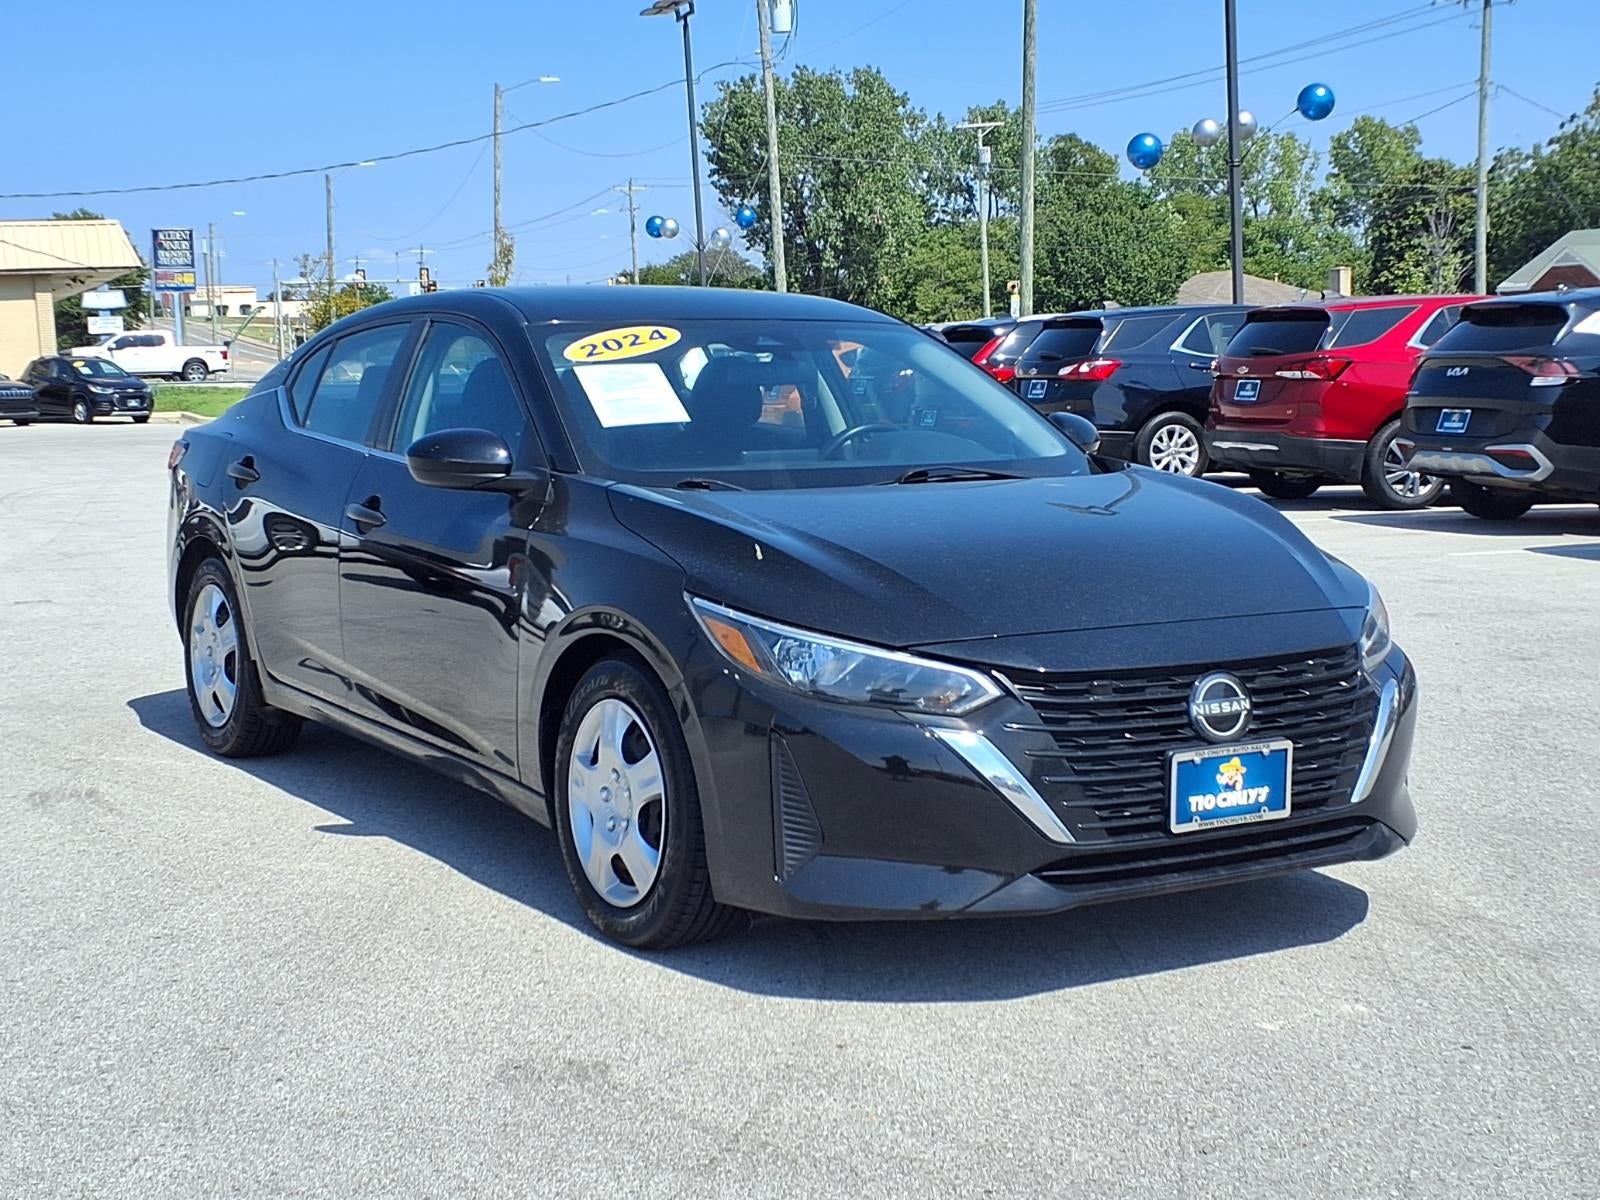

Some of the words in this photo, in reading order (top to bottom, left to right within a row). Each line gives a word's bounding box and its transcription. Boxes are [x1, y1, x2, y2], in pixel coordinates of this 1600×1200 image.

[580, 329, 667, 358] 2024
[1192, 699, 1251, 715] NISSAN
[1188, 793, 1216, 812] TIO
